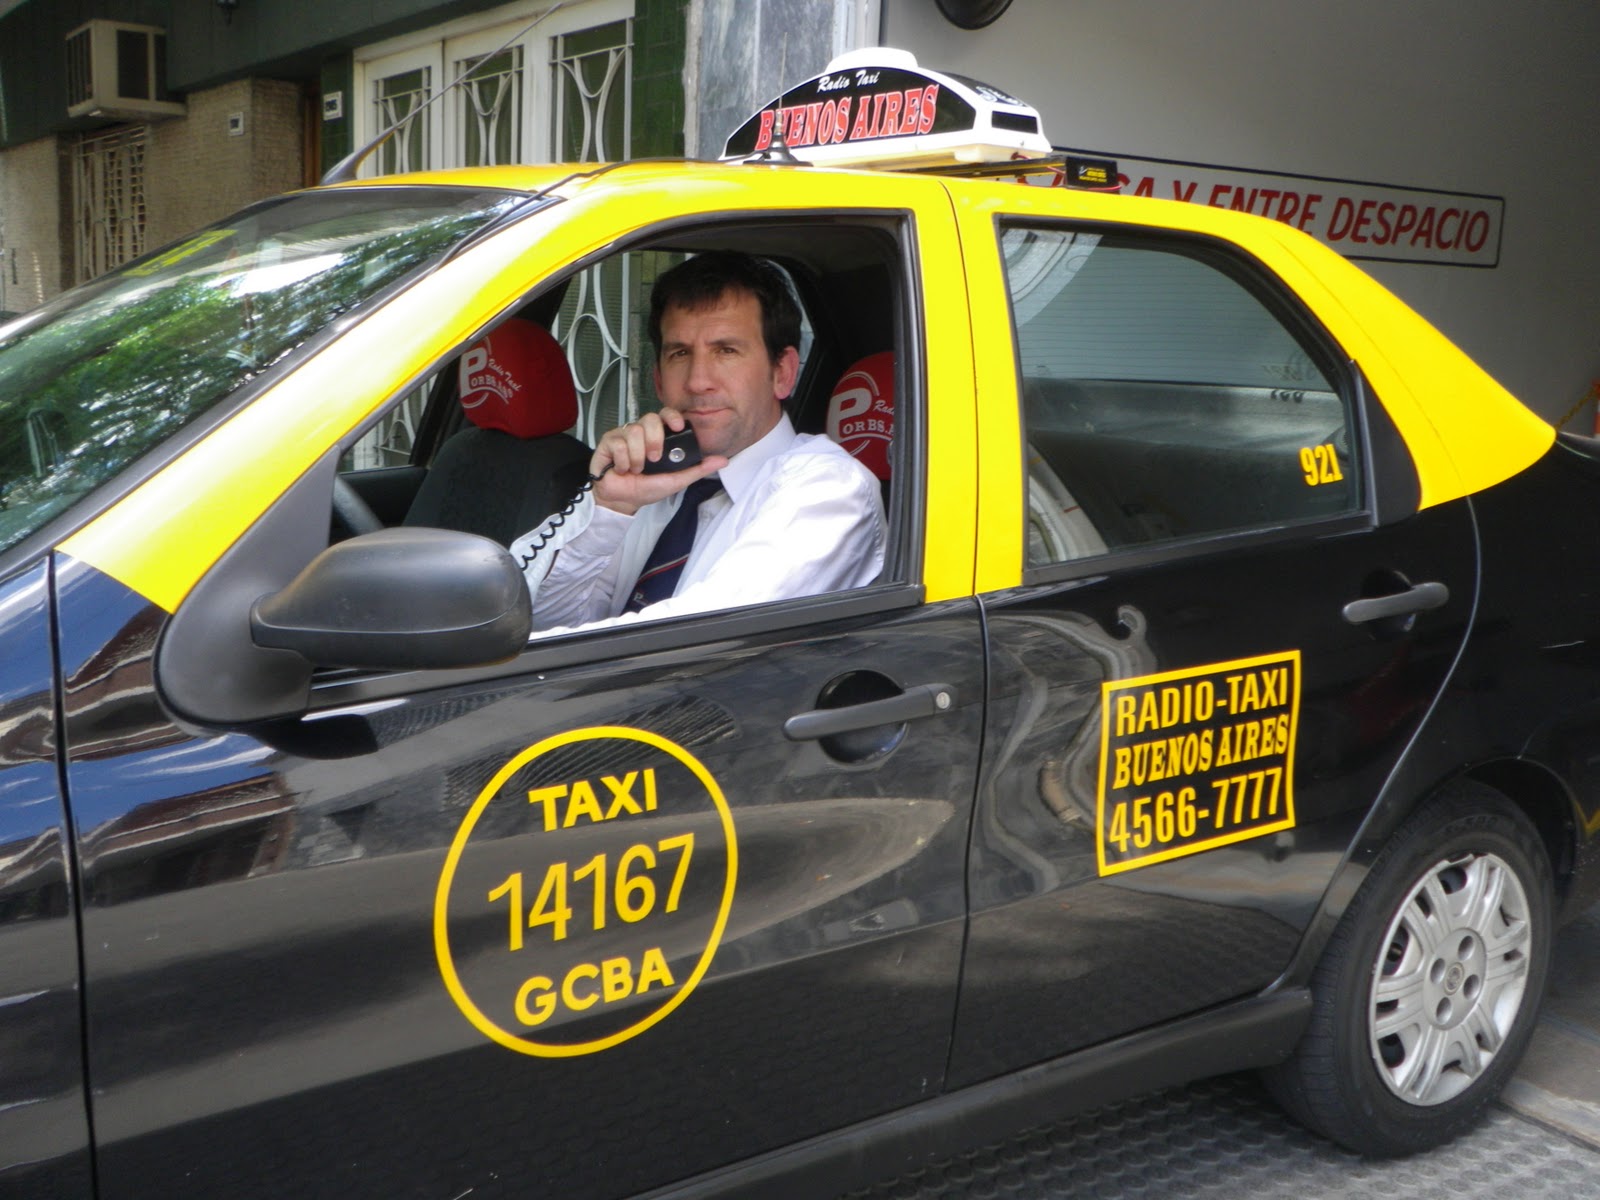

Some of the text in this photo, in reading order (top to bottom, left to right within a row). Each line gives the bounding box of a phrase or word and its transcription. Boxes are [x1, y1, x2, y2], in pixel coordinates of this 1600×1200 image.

[817, 69, 881, 93] Radio Taxi
[849, 84, 940, 141] AIRES
[1326, 196, 1490, 253] DESPACIO
[871, 399, 895, 416] Rad
[1299, 443, 1344, 487] 921
[1115, 667, 1289, 737] RADIO-TAXI
[1112, 713, 1290, 790] BUENOS AIRES
[528, 767, 658, 833] TAXI
[1109, 766, 1283, 853] 4566-7777
[488, 832, 695, 952] 14167
[514, 947, 676, 1027] GCBA
